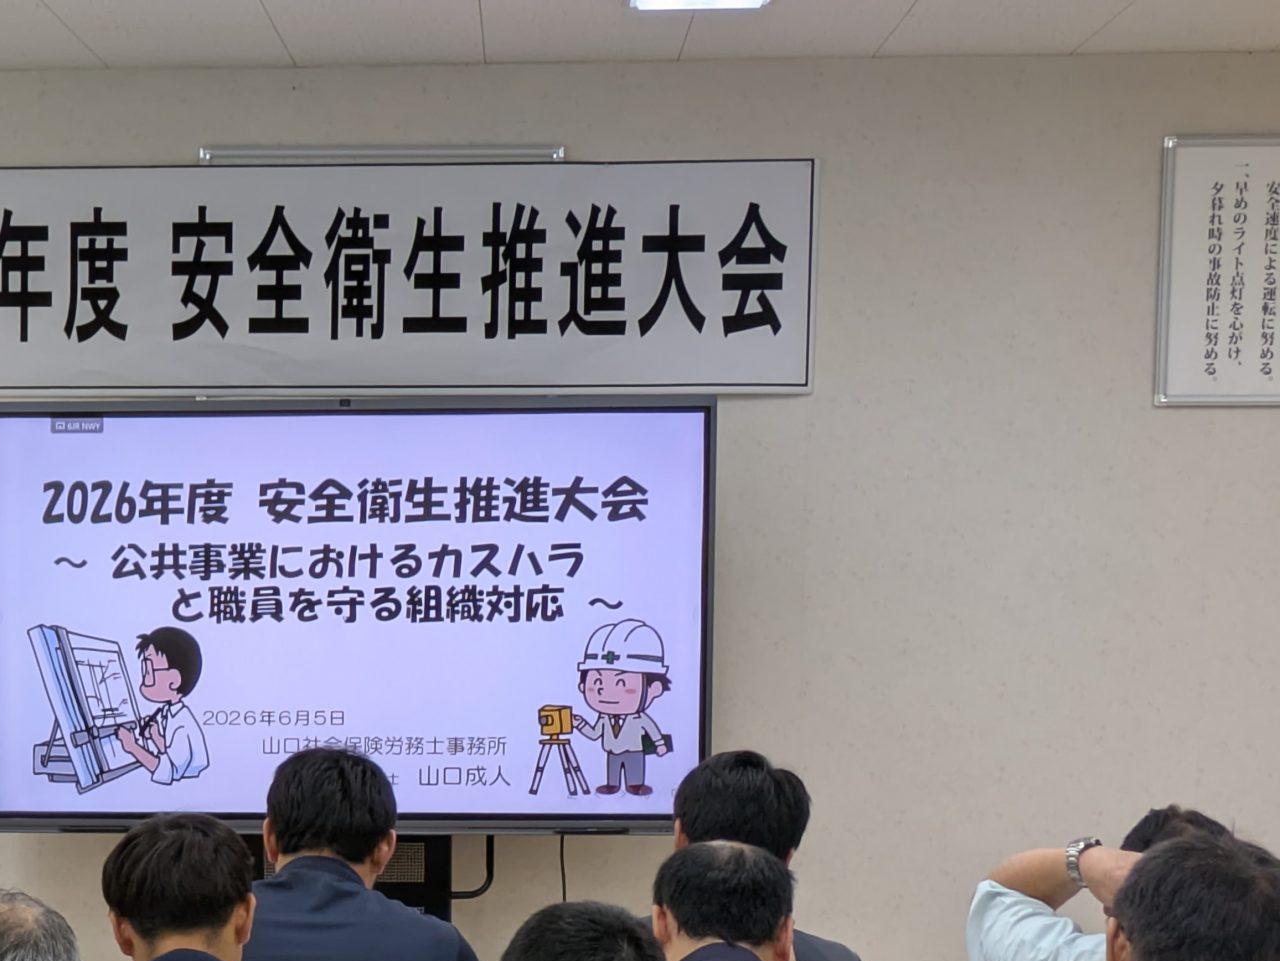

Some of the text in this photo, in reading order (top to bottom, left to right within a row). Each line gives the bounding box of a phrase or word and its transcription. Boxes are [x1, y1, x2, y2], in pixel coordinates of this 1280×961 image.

[172, 202, 787, 340] 安全衛生推進大会
[43, 476, 648, 525] 2026年度 安全衛生推進大会
[111, 543, 583, 581] 公共事業におけるカスハラ
[172, 584, 564, 624] と職員を守る組織対応
[203, 710, 345, 726] 2026年6月5日
[419, 765, 510, 786] 山口成人
